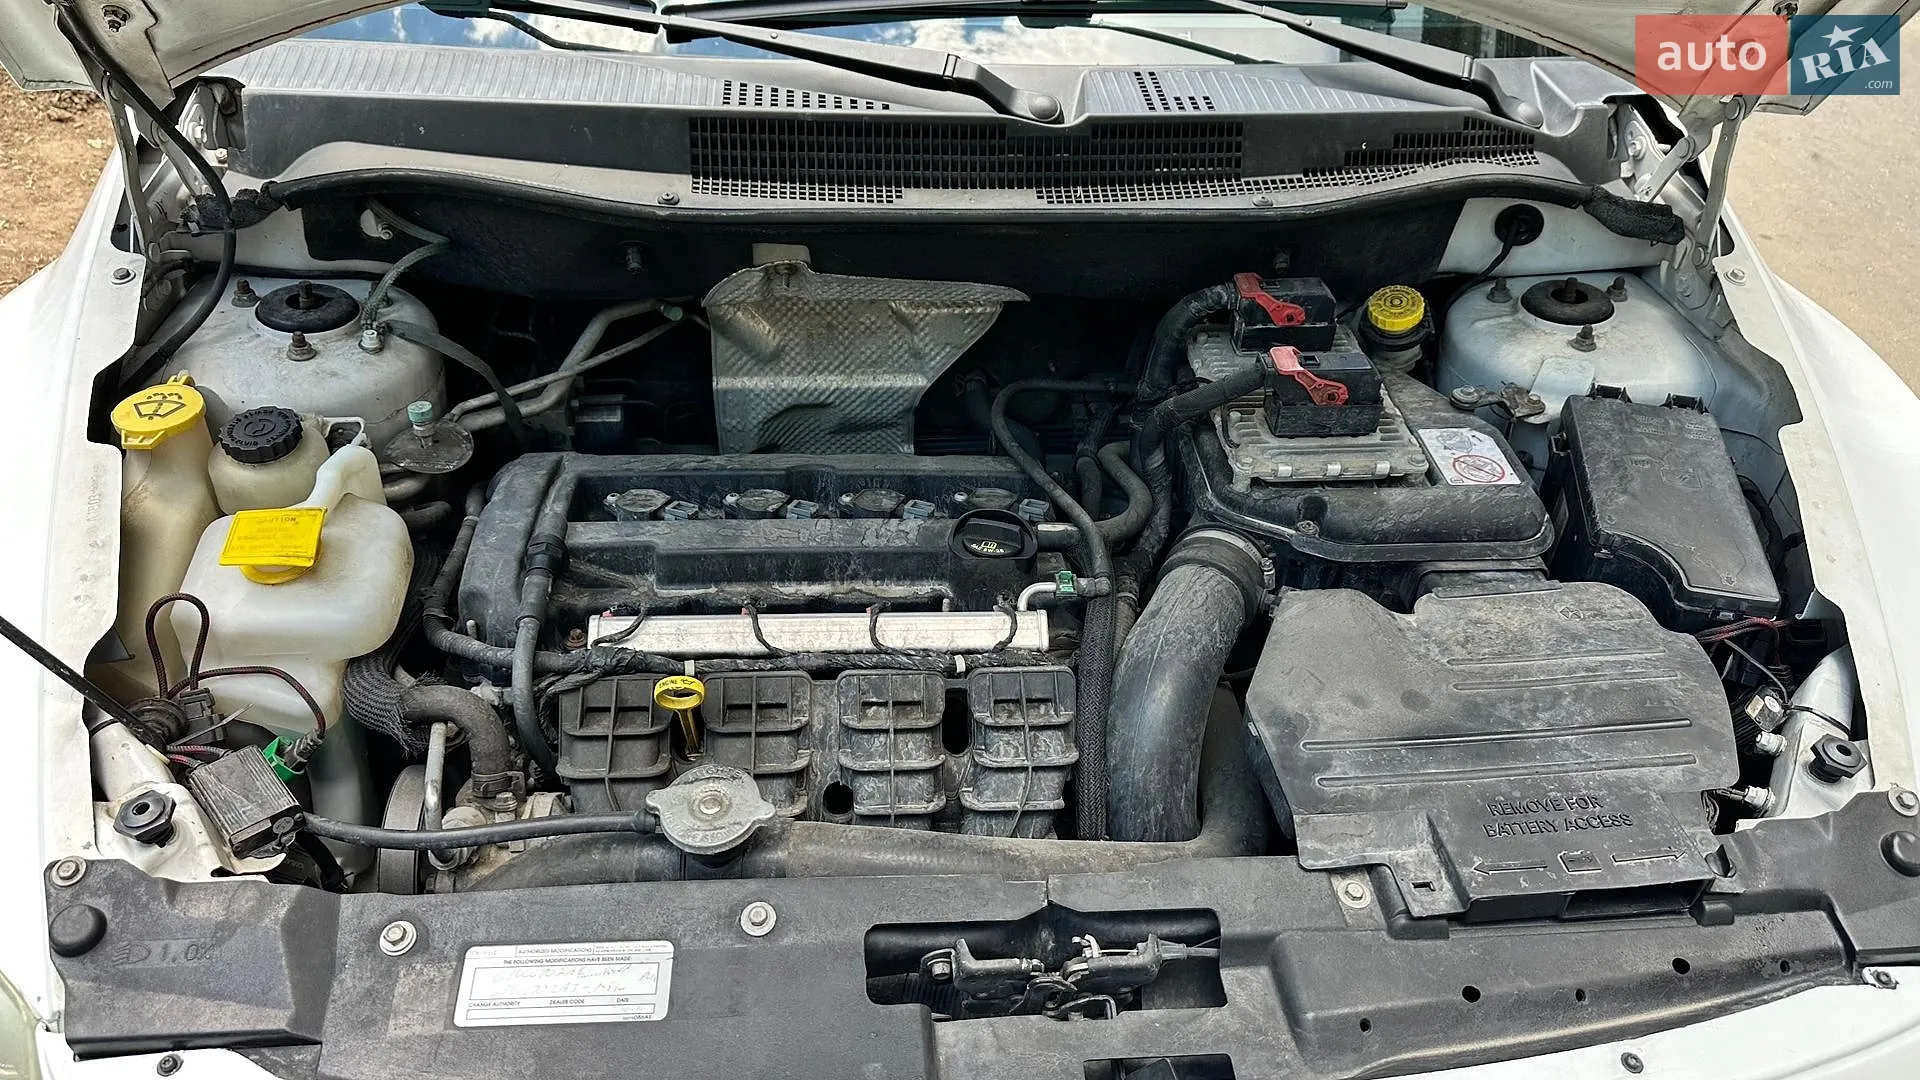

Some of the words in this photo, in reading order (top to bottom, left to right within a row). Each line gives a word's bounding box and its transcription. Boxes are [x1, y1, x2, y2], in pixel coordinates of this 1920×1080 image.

[1486, 799, 1565, 817] REMOVE
[1564, 796, 1604, 811] FOR
[1482, 819, 1559, 838] BATTERY
[1564, 813, 1634, 832] ACCESS
